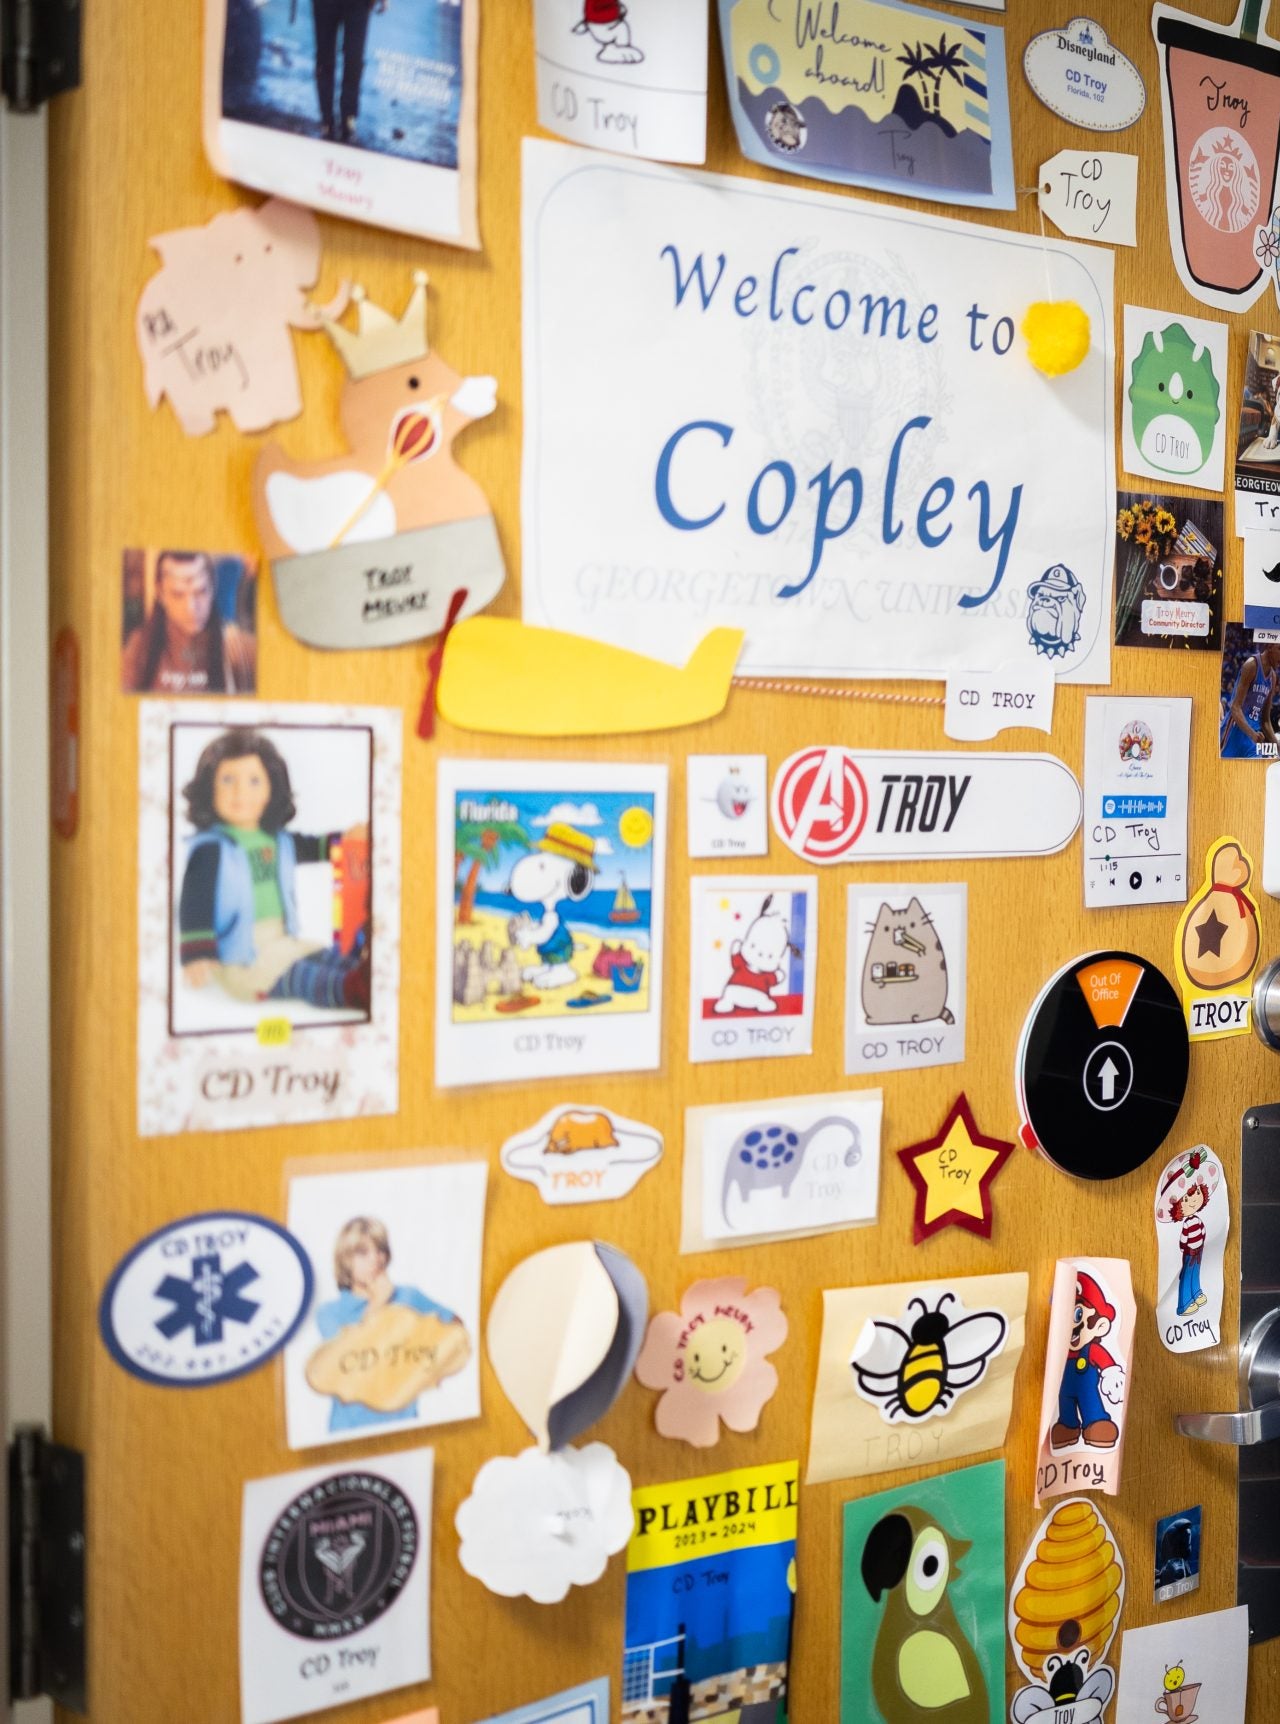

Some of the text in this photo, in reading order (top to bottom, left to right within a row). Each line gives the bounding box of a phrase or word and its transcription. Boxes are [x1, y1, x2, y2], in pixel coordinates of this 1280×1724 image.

[768, 0, 893, 53] Welcome
[1056, 34, 1116, 66] Disneyland
[1065, 69, 1107, 94] CD Troy
[1067, 84, 1105, 103] Florida, 102
[1199, 75, 1251, 128] Troy
[552, 81, 640, 148] CD Troy
[878, 129, 916, 176] Troy
[1081, 158, 1103, 181] CD
[1060, 172, 1112, 233] Troy
[660, 245, 939, 345] Welcome
[966, 302, 1016, 356] to
[160, 326, 250, 391] Troy
[1155, 433, 1167, 453] CD
[653, 415, 1025, 609] Copley
[875, 583, 1028, 621] UNIVERSI
[1156, 606, 1196, 620] Troy Meury
[1148, 618, 1206, 629] Community Director
[959, 689, 1036, 710] CD TROY
[1256, 742, 1278, 756] PIZZA
[459, 799, 517, 824] Florida
[875, 775, 972, 834] TROY
[1092, 823, 1160, 851] CD Troy
[1090, 972, 1122, 987] Out Of
[1091, 986, 1120, 1002] Office
[1192, 1000, 1249, 1029] TROY
[513, 1033, 586, 1054] CD Troy
[712, 1026, 796, 1048] CD TROY
[862, 1036, 945, 1060] CD TROY
[201, 1064, 342, 1101] CD Troy
[813, 1153, 839, 1171] CD
[938, 1149, 958, 1164] CD
[550, 1168, 607, 1190] TROY
[939, 1165, 972, 1185] Troy
[806, 1180, 843, 1201] Troy
[1165, 1318, 1219, 1346] CD Troy
[1036, 1459, 1106, 1496] CD Troy
[637, 1479, 798, 1538] PLAYBILL
[675, 1530, 707, 1549] 2023
[723, 1521, 756, 1538] 2024
[671, 1569, 730, 1595] CD Troy
[1159, 1585, 1174, 1601] CD
[299, 1647, 379, 1680] CD Troy
